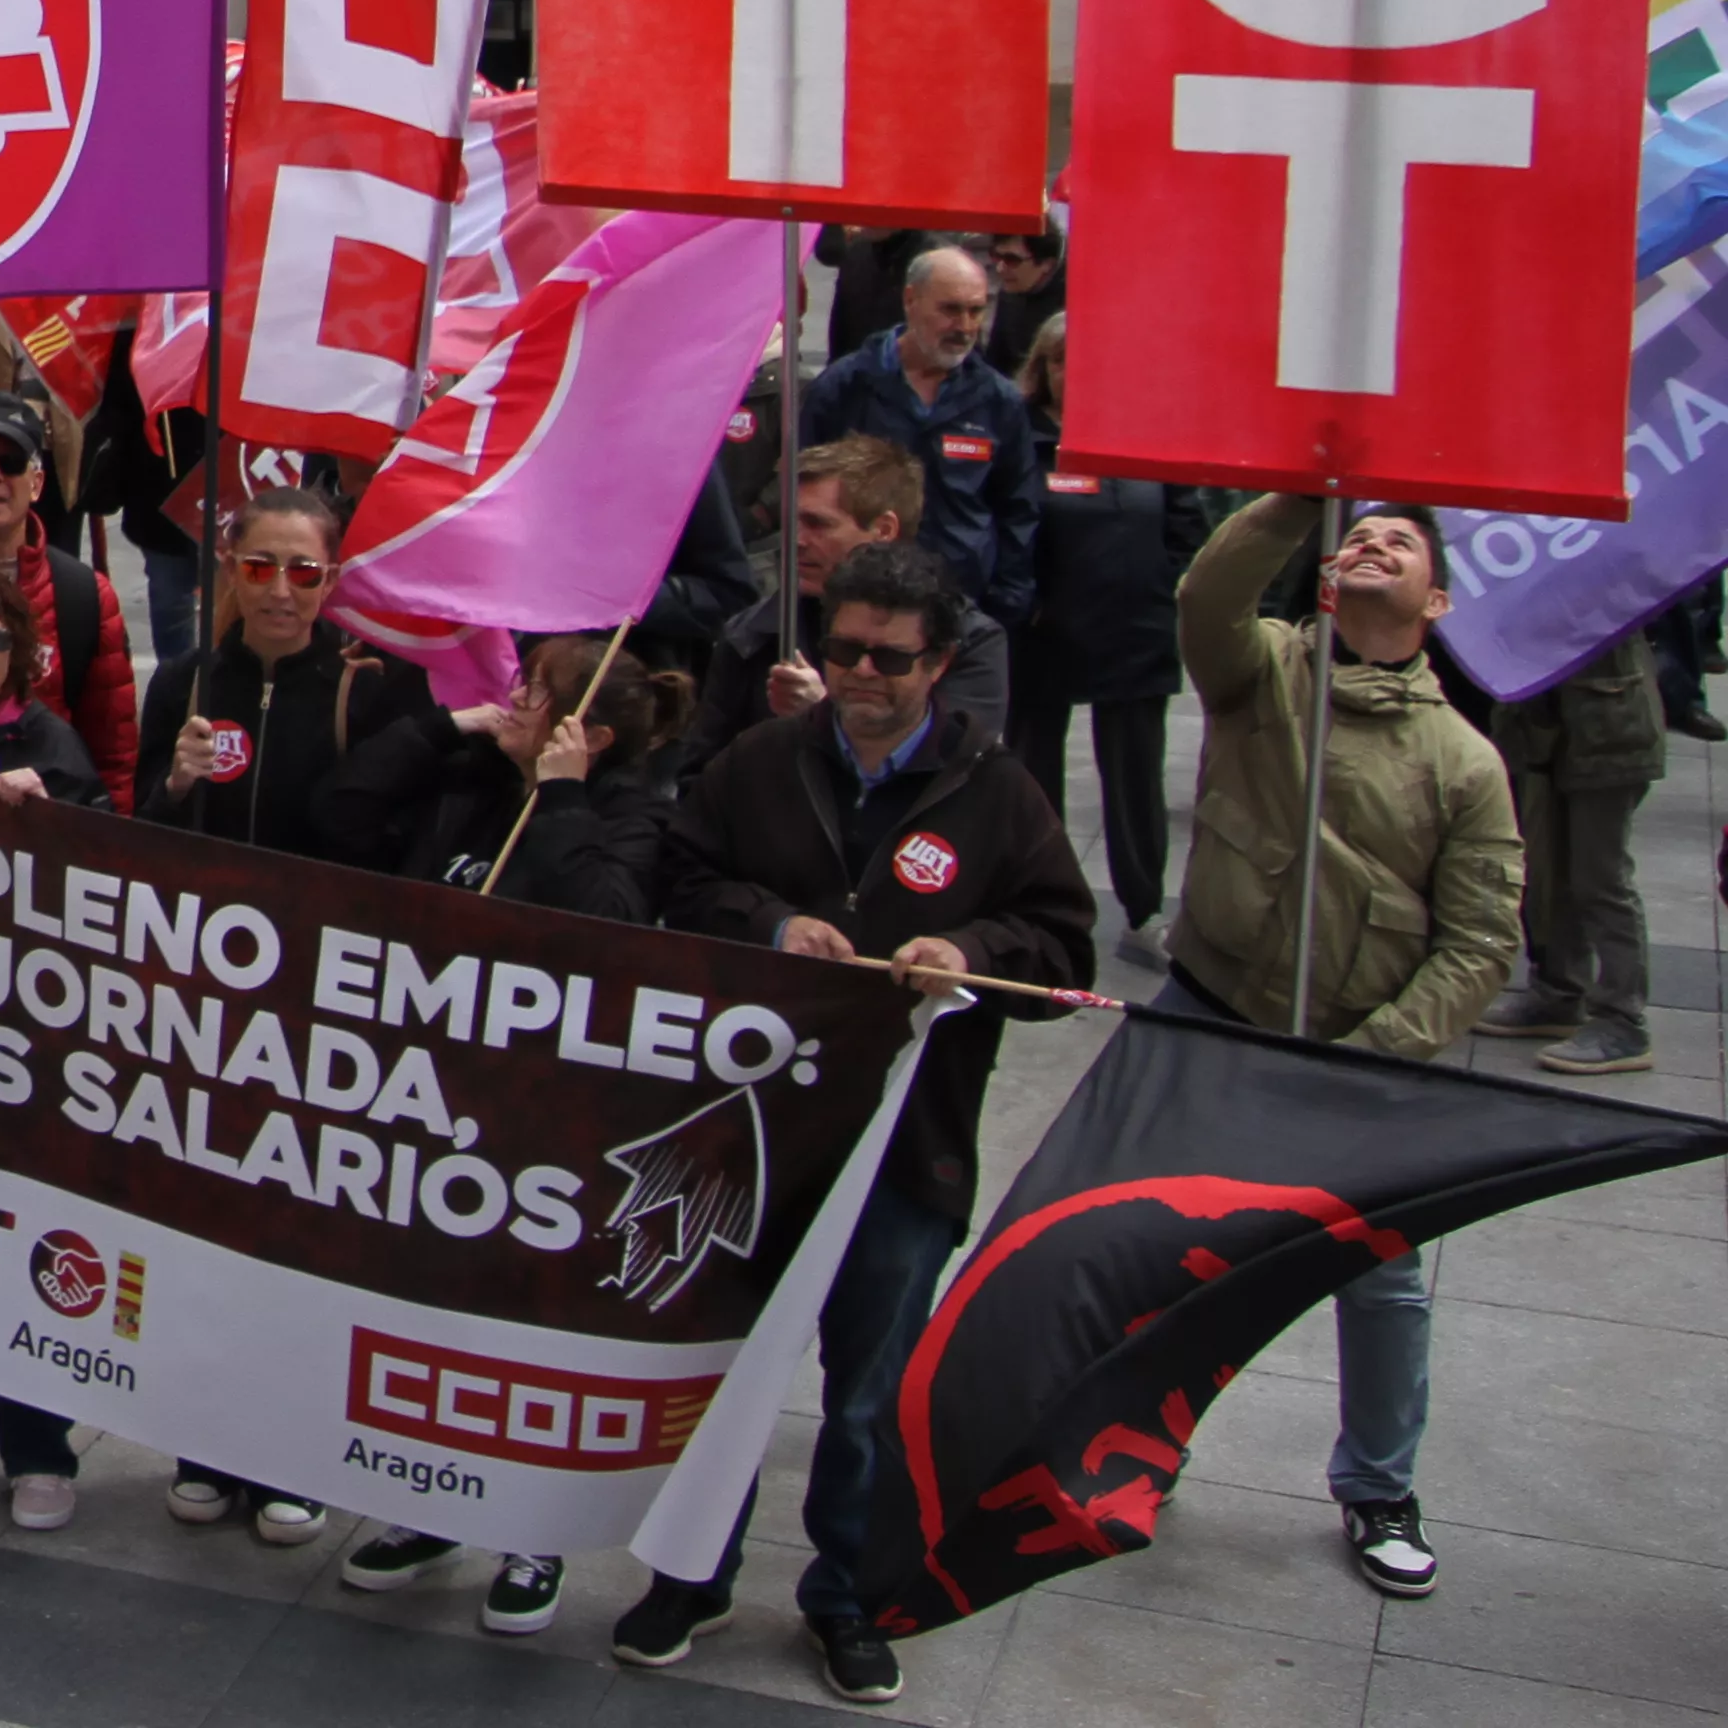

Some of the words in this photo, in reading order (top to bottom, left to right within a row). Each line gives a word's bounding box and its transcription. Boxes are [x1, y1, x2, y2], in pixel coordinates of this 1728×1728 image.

[214, 730, 242, 755] GT
[897, 835, 953, 877] UGT
[313, 927, 820, 1087] EMPLEO:
[60, 1052, 584, 1252] SALARIOS
[9, 1320, 136, 1393] Aragón
[368, 1351, 645, 1454] CCOO
[343, 1439, 487, 1501] Aragón
